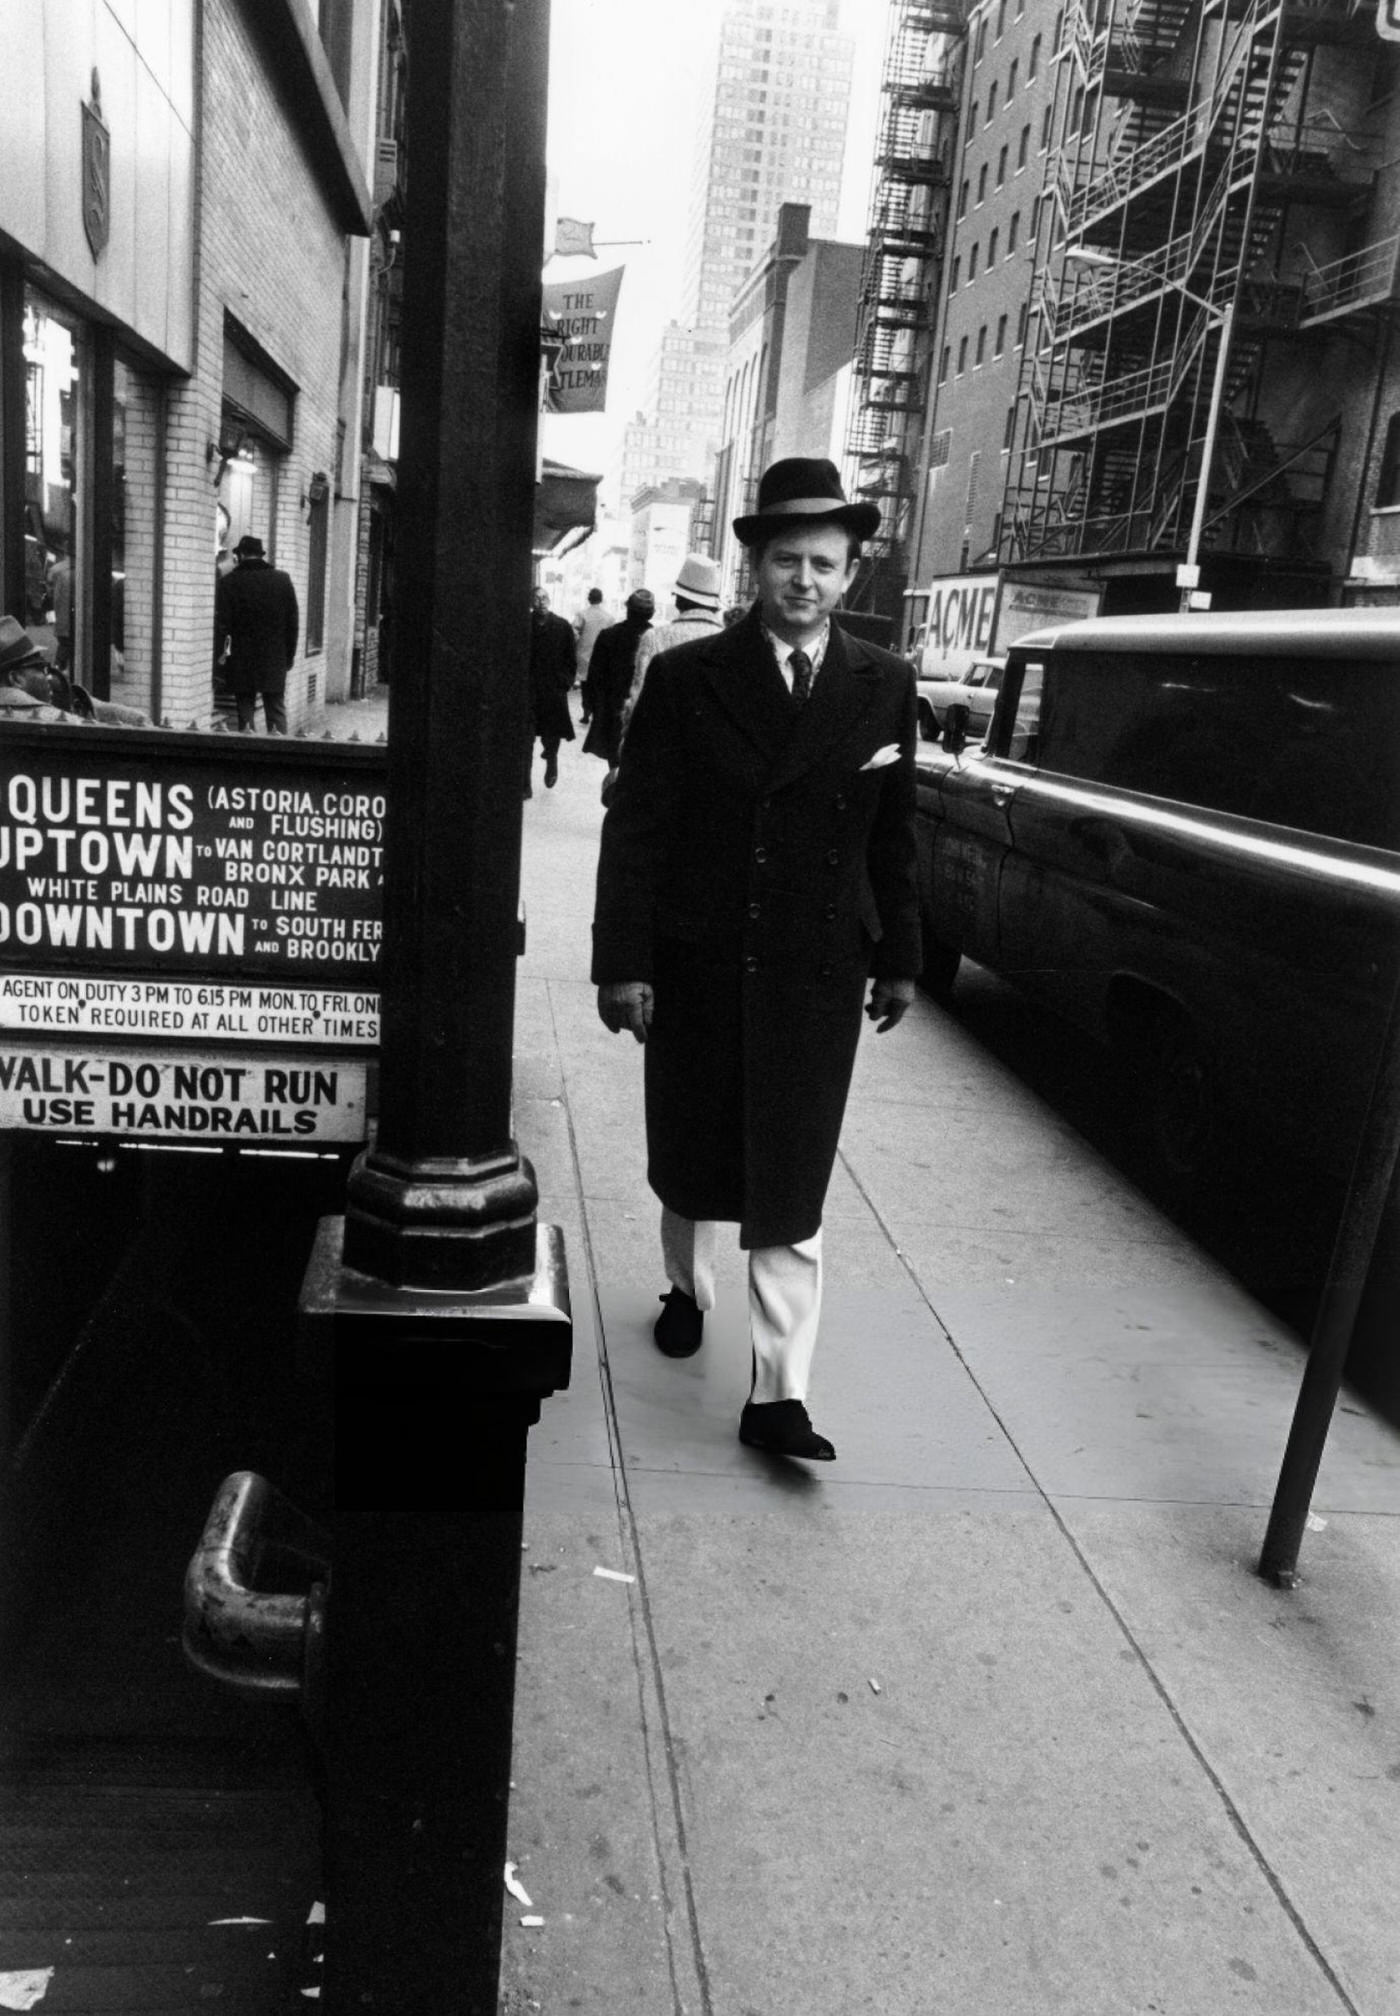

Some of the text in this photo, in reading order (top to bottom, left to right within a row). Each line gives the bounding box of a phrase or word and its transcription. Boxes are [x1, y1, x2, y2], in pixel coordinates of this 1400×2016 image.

[562, 293, 594, 310] THE
[557, 317, 600, 336] RIGHT
[926, 586, 996, 656] ACME
[8, 774, 194, 830] QUEENS
[229, 814, 383, 843] AND FLUSHING)
[196, 845, 212, 857] TO
[215, 838, 253, 860] VAN
[262, 840, 384, 867] CORTLANDT
[225, 861, 305, 886] BRONX
[315, 867, 370, 889] PARK
[27, 876, 318, 911] WHITE PLAINS ROAD LINE
[252, 918, 268, 930] TO
[275, 916, 345, 939] SOUTH
[255, 939, 381, 962] AND BROOKLY
[3, 979, 53, 998] AGENT
[58, 981, 79, 999] ON
[86, 983, 127, 1001] DUTY
[131, 985, 141, 1003] 3
[145, 986, 169, 1003] PM
[173, 987, 192, 1005] TO
[229, 990, 252, 1008] PM
[259, 991, 297, 1010] MON.
[299, 993, 317, 1011] TO
[323, 994, 350, 1013] FRI.
[18, 1004, 377, 1038] TOKEN REQUIRED AT ALL OTHER TIMES
[174, 1066, 246, 1102] NOT
[264, 1069, 337, 1105] RUN
[23, 1098, 317, 1134] USE HANDRAILS
